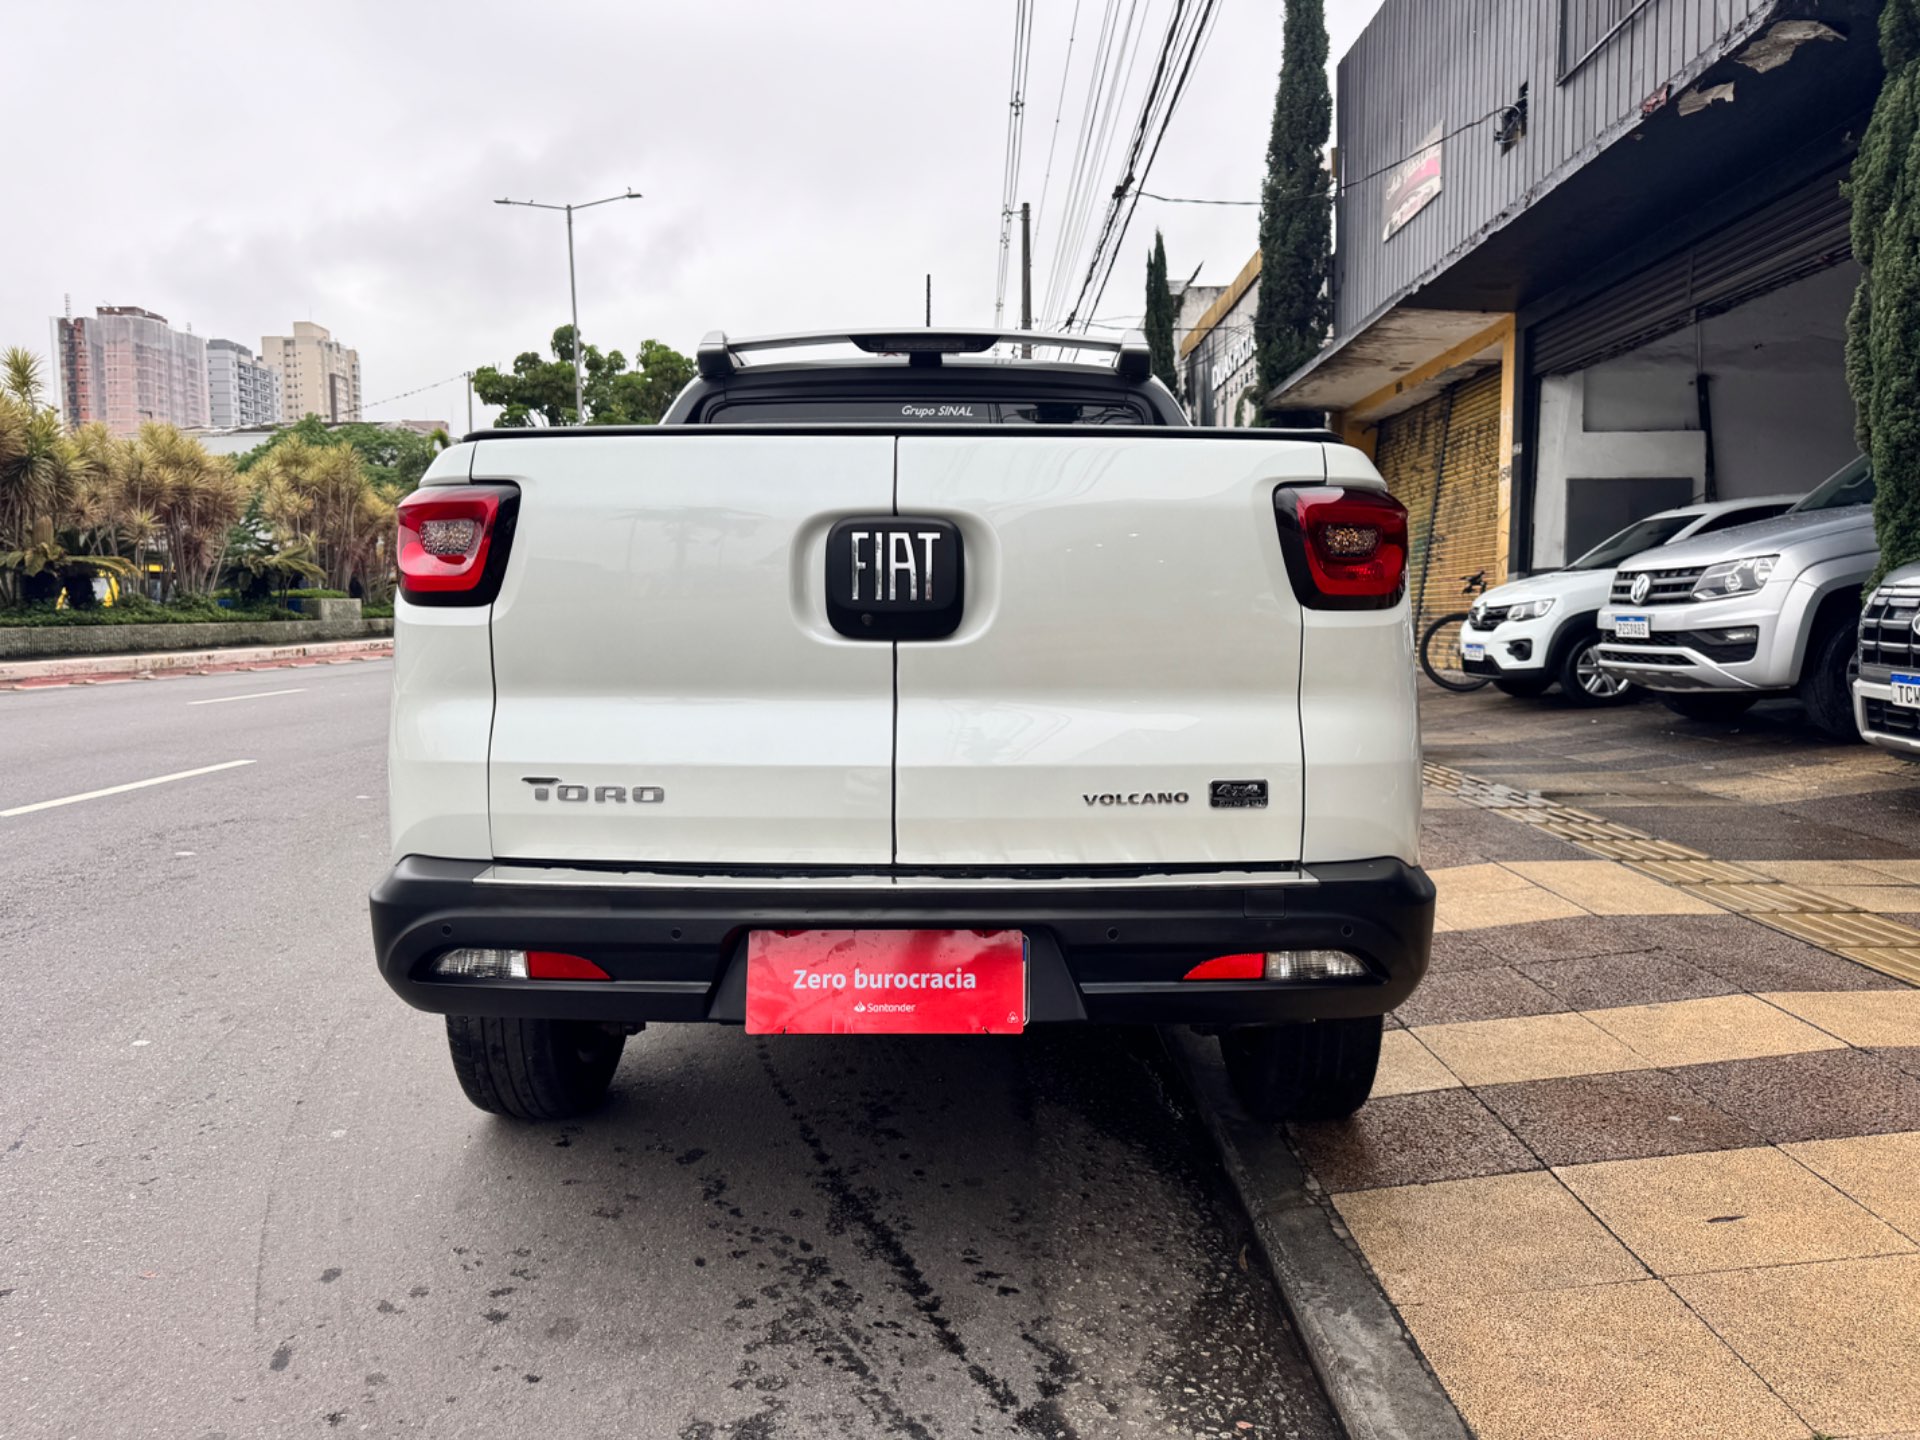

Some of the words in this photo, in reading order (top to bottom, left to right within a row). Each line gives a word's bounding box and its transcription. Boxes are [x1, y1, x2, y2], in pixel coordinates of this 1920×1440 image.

[901, 405, 935, 418] Grupo
[938, 405, 973, 416] SINAL
[851, 532, 941, 601] FIAT
[521, 777, 664, 803] TORO
[1083, 792, 1189, 806] VOLCANO
[793, 969, 847, 989] Zero
[854, 968, 976, 989] burocracia
[867, 1002, 916, 1013] Santander
